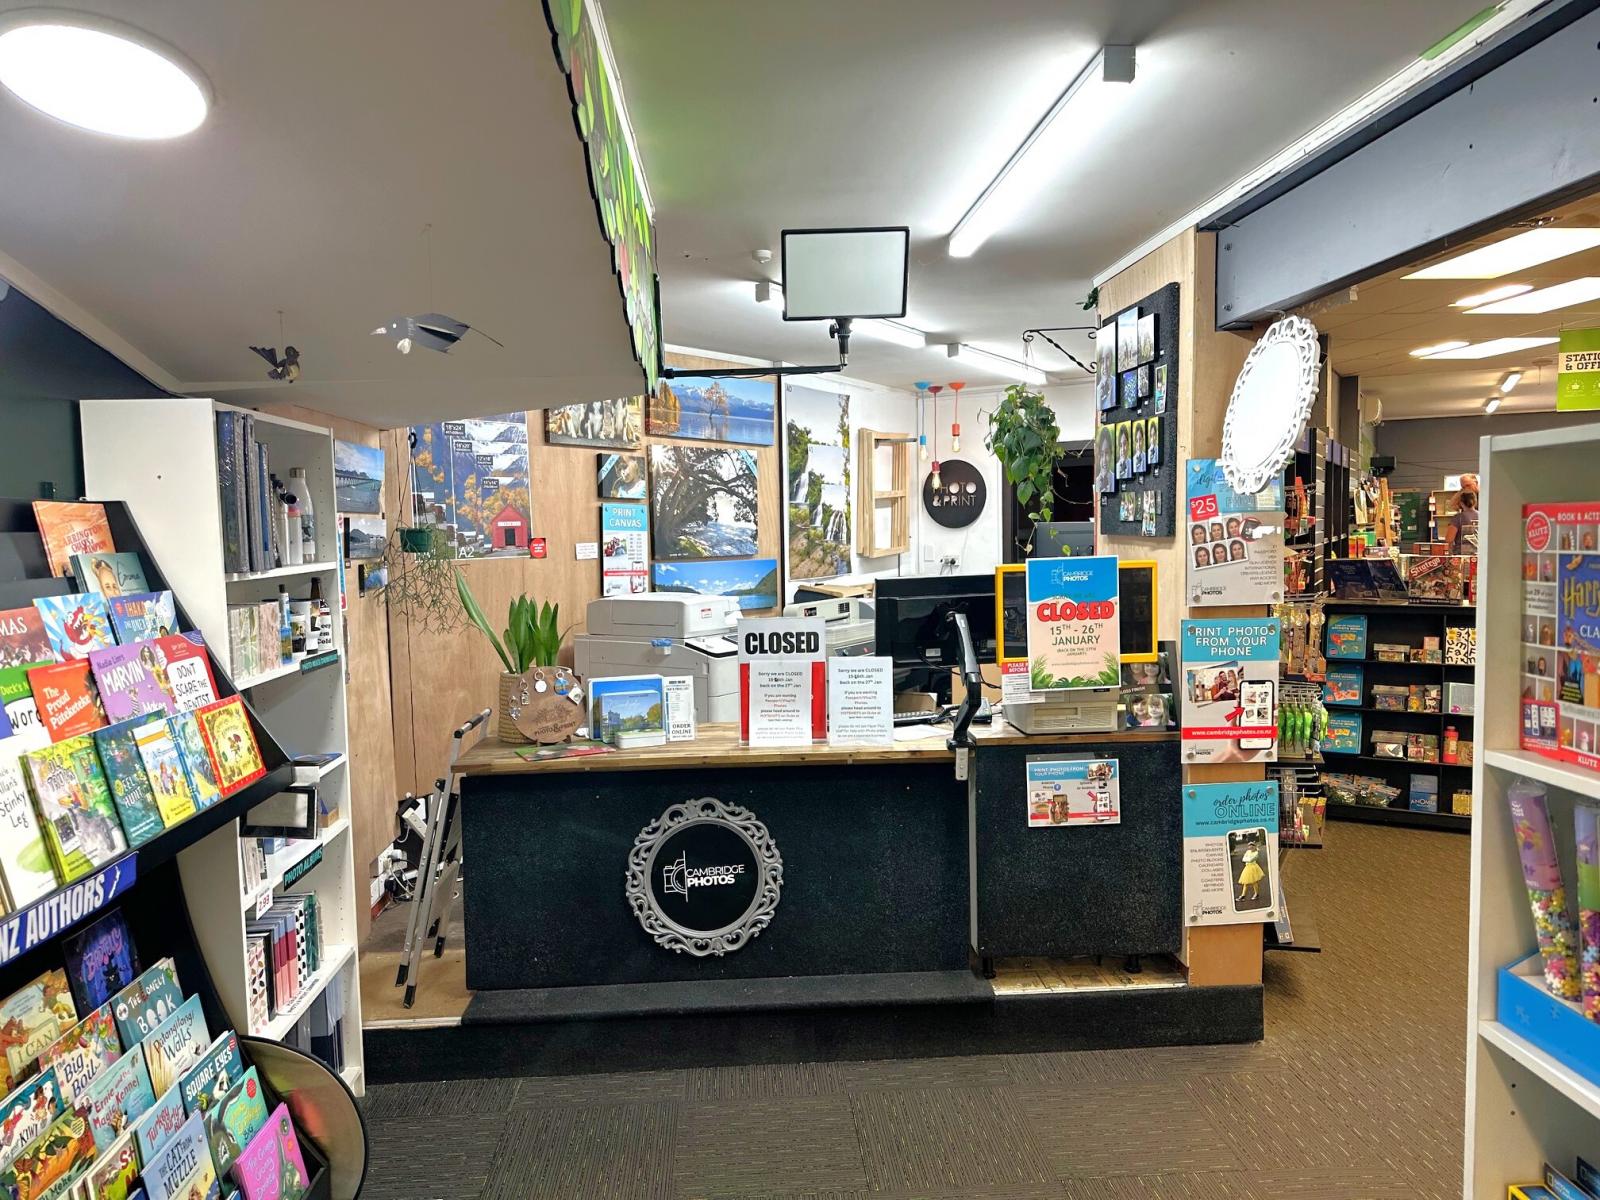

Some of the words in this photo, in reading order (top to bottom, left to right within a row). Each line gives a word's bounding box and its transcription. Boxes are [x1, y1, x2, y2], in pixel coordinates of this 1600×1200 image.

[932, 482, 977, 494] HOTO
[944, 495, 976, 507] PRINT
[613, 508, 636, 516] PRINT
[1558, 512, 1575, 520] BOOK
[609, 519, 642, 528] CANVAS
[459, 547, 474, 558] A2
[1411, 558, 1441, 576] Stratego
[1037, 601, 1115, 622] CLOSED
[1050, 624, 1071, 636] 15TH
[1082, 623, 1104, 634] 26TH
[745, 632, 820, 654] CLOSED
[1052, 635, 1100, 646] JANUARY
[1196, 636, 1229, 646] FROM
[1236, 636, 1266, 646] YOUR
[1211, 647, 1252, 656] PHONE
[101, 657, 146, 697] MARVIN
[43, 686, 60, 700] The
[175, 680, 198, 698] SCARE
[198, 679, 209, 689] THE
[46, 689, 71, 715] Proud
[183, 694, 211, 713] DENTIST
[1578, 756, 1598, 768] KLUTZ
[0, 790, 27, 818] Stinky
[124, 786, 144, 808] HUNT
[1214, 795, 1236, 806] order
[1238, 788, 1268, 804] photos
[10, 811, 29, 829] Leg
[1215, 803, 1276, 818] ONLINE
[284, 865, 303, 887] PHOTO
[686, 864, 745, 878] CAMBRIDGE
[687, 875, 735, 888] PHOTOS
[26, 874, 105, 949] AUTHORS
[128, 993, 141, 1008] THE
[136, 994, 178, 1034] BOOK
[17, 1050, 23, 1064] I
[25, 1030, 56, 1058] CAN
[163, 1028, 193, 1062] Walks
[64, 1053, 85, 1083] Big
[186, 1063, 214, 1102] SQUARE
[216, 1046, 233, 1072] EYES
[115, 1076, 140, 1105] Kennel
[94, 1088, 115, 1114] Ernie
[20, 1124, 38, 1148] KIWI
[146, 1106, 170, 1150] Turkey
[166, 1140, 182, 1170] CAT
[164, 1148, 198, 1198] MUZZLE
